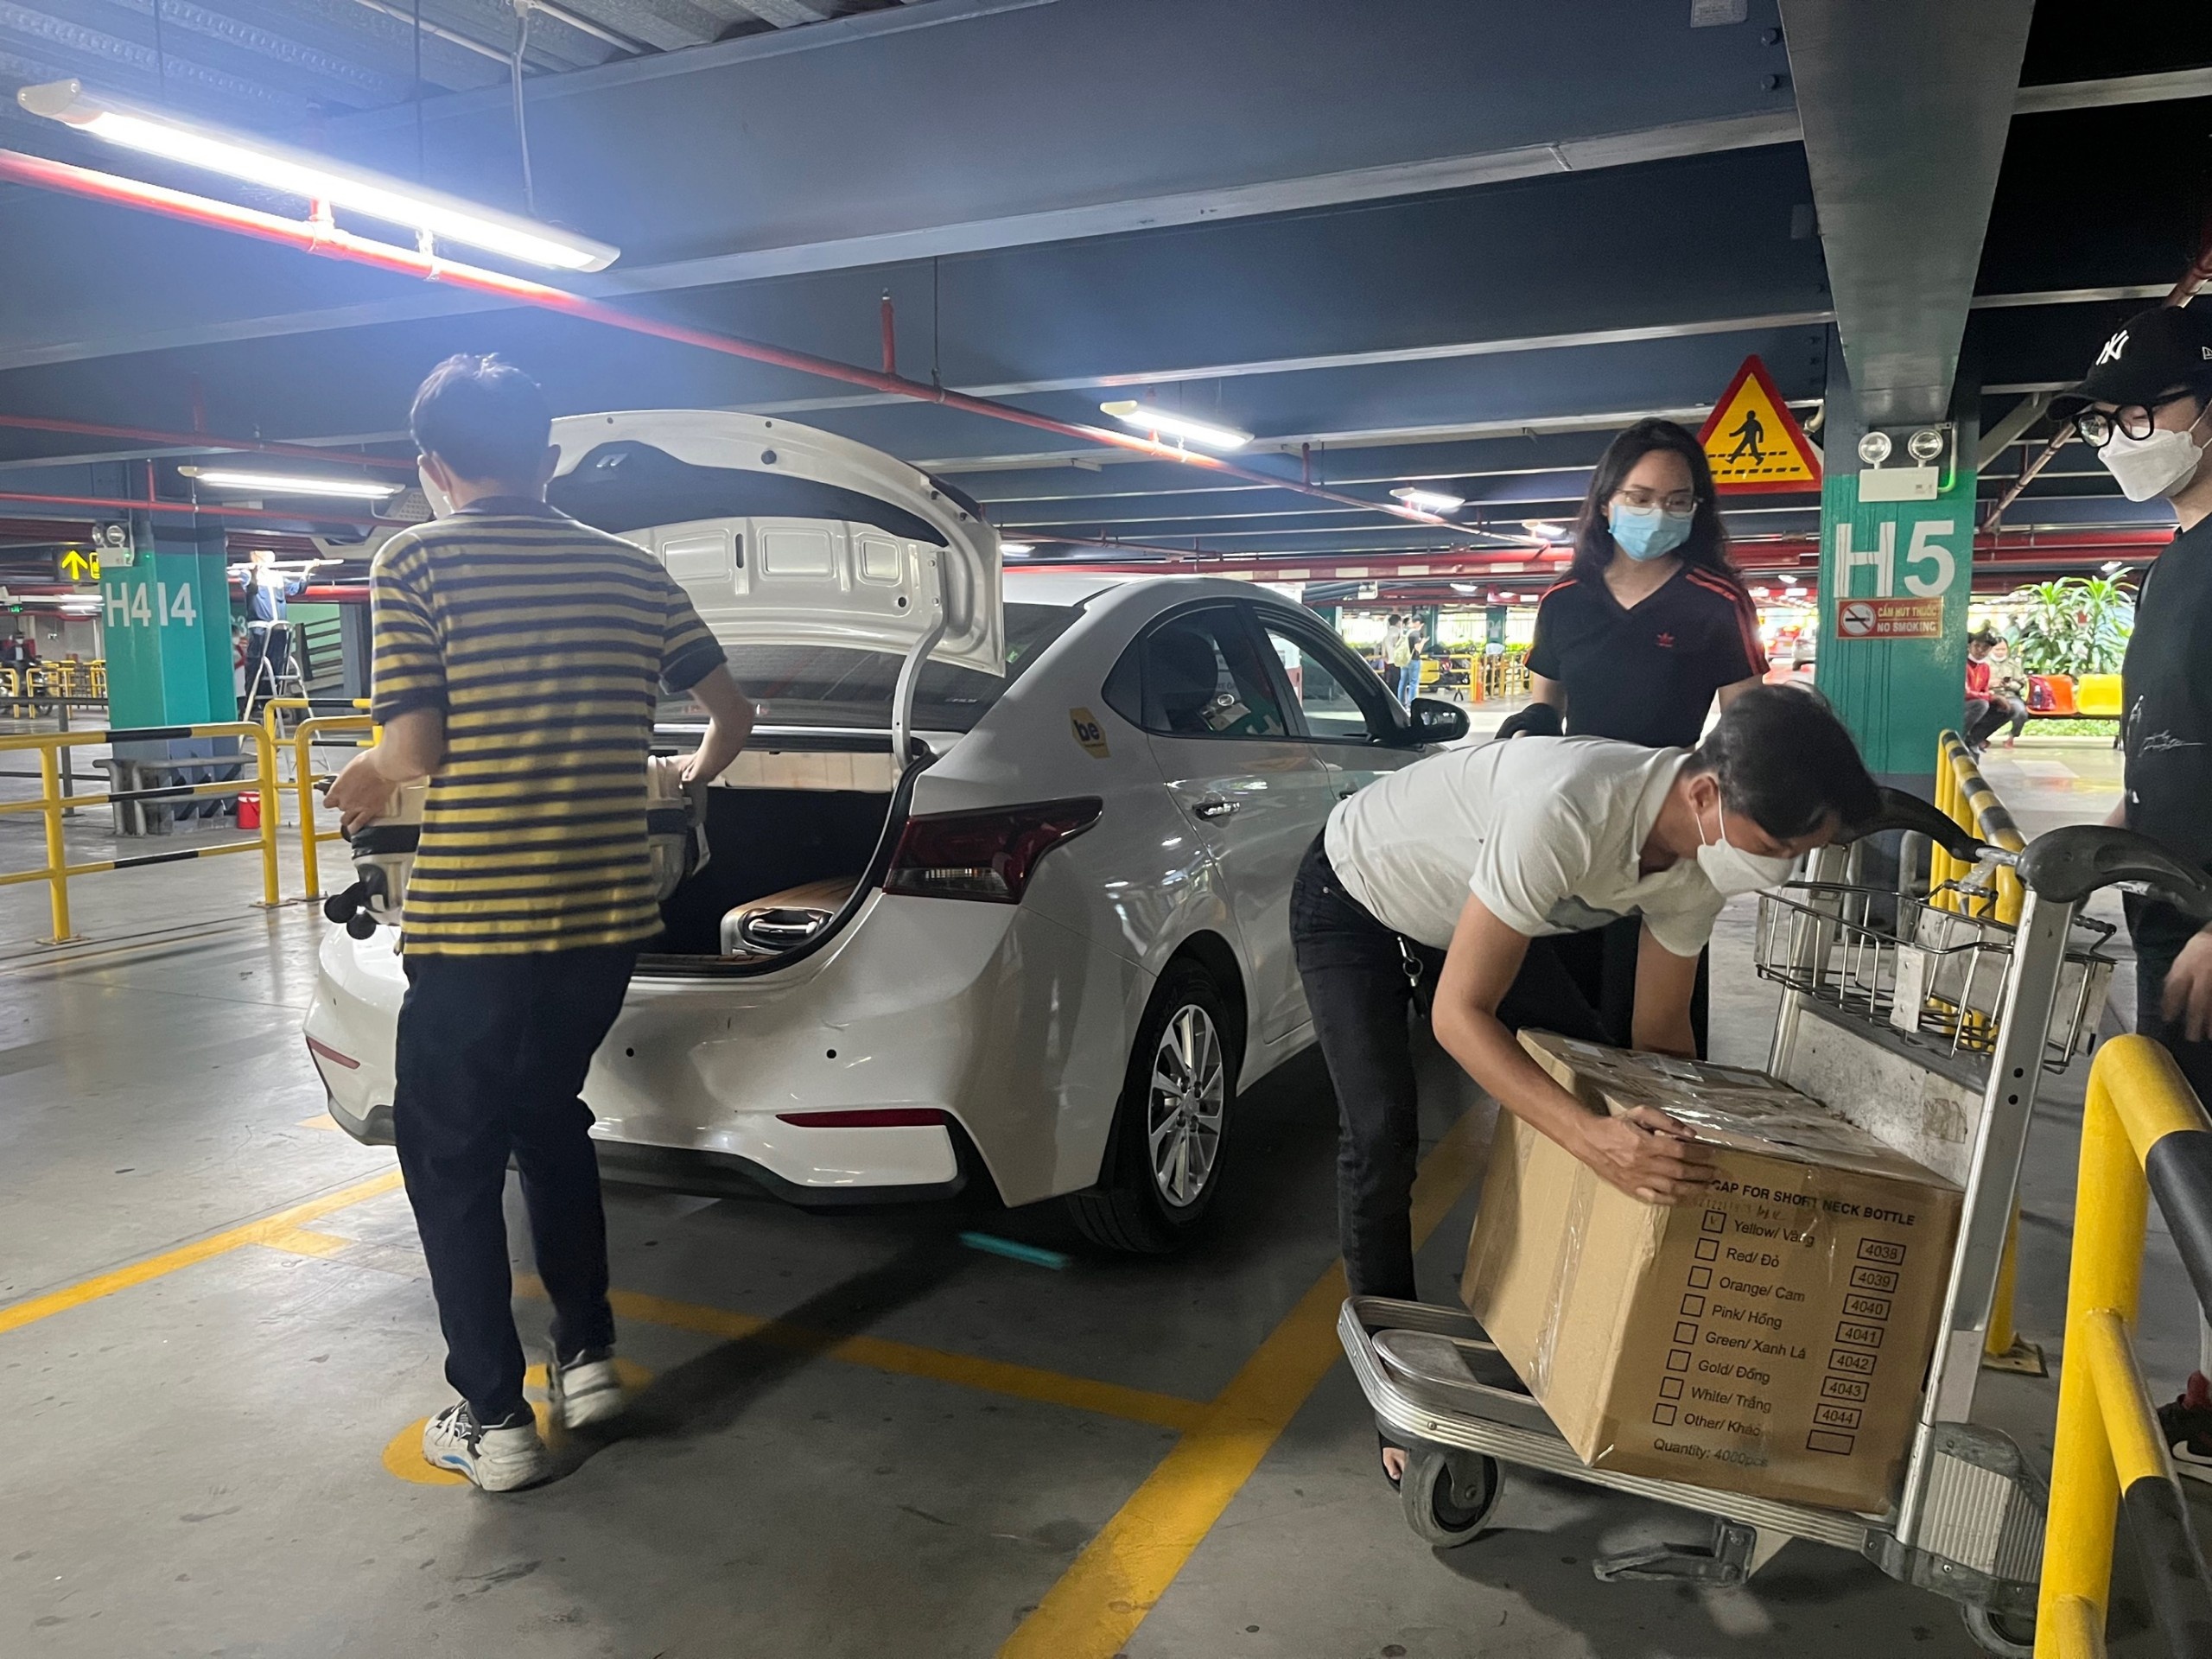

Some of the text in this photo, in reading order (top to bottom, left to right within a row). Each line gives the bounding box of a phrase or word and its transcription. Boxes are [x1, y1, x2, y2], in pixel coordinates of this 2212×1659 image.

[1834, 519, 1955, 598] H5
[1877, 621, 1936, 632] NO SMOKING
[1073, 719, 1100, 742] be
[1742, 1184, 1770, 1200] FOR
[1822, 1199, 1859, 1217] NECK
[1863, 1207, 1916, 1226] BOTTLE
[1734, 1219, 1780, 1239] Yellow/
[1726, 1247, 1758, 1264] Red/
[1865, 1243, 1898, 1261] 4038
[1858, 1271, 1891, 1287] 4039
[1719, 1276, 1806, 1303] Orange/ Cam
[1712, 1304, 1746, 1321] Pink/
[1851, 1299, 1884, 1315] 4040
[1844, 1326, 1877, 1344] 4041
[1705, 1331, 1751, 1350] Green/
[1751, 1339, 1787, 1357] Xanh
[1698, 1359, 1734, 1376] Gold/
[1836, 1354, 1869, 1370] 4042
[1691, 1386, 1733, 1404] White/
[1828, 1382, 1862, 1397] 4043
[1684, 1413, 1726, 1430] Other/
[1821, 1408, 1854, 1425] 4044
[1653, 1437, 1711, 1460] Quantity:
